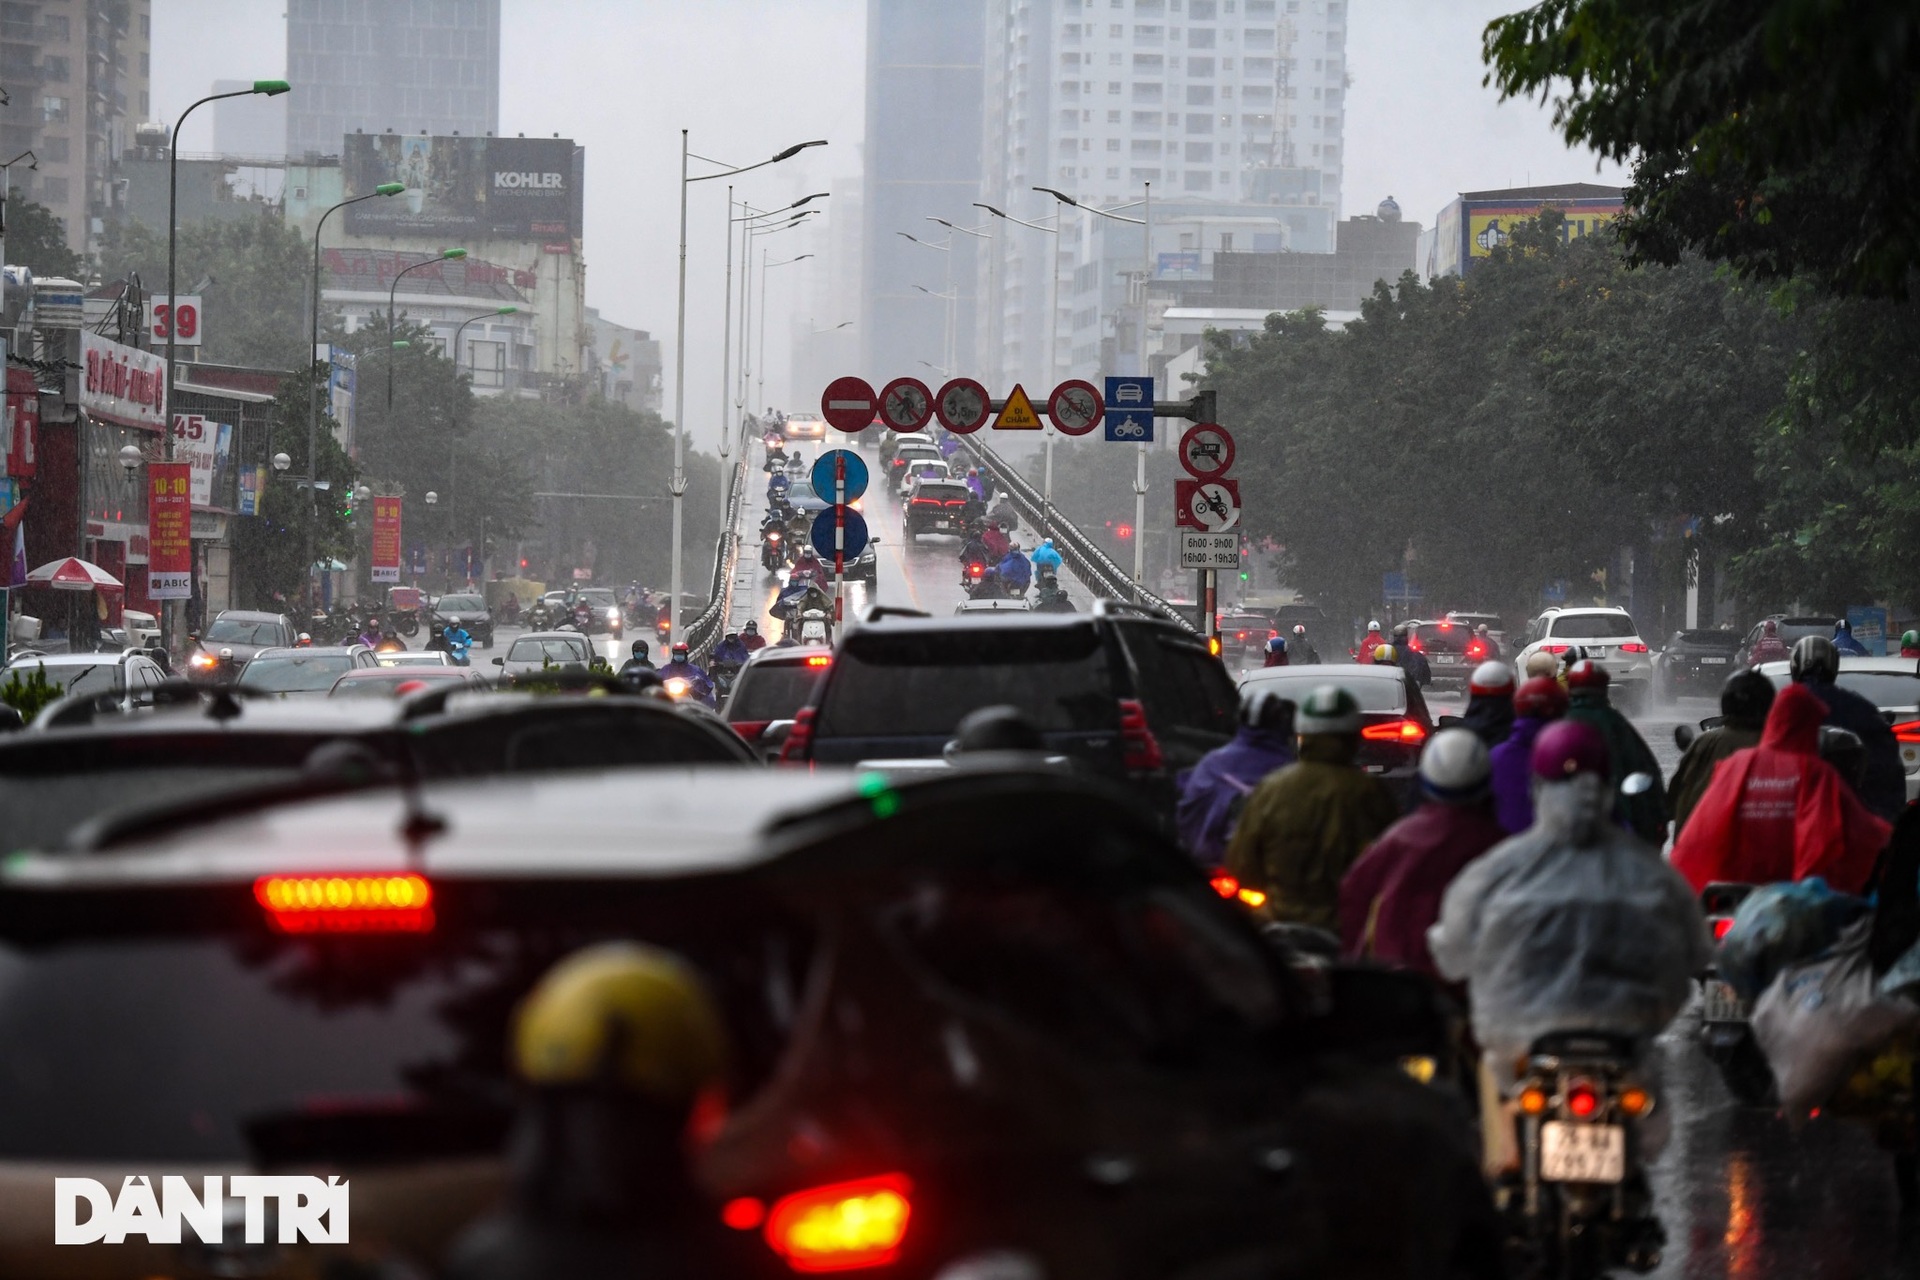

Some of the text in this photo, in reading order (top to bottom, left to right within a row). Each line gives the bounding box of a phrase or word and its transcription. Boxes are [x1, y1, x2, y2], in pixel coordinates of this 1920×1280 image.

[495, 171, 563, 188] KOHLER
[154, 304, 197, 338] 39
[948, 399, 977, 419] 3,5m
[173, 416, 203, 440] 45
[1188, 538, 1207, 549] 6h00
[1214, 538, 1234, 549] 9h00
[1183, 552, 1206, 564] 16h00
[1214, 552, 1238, 564] 19h30
[163, 579, 189, 588] ABIC
